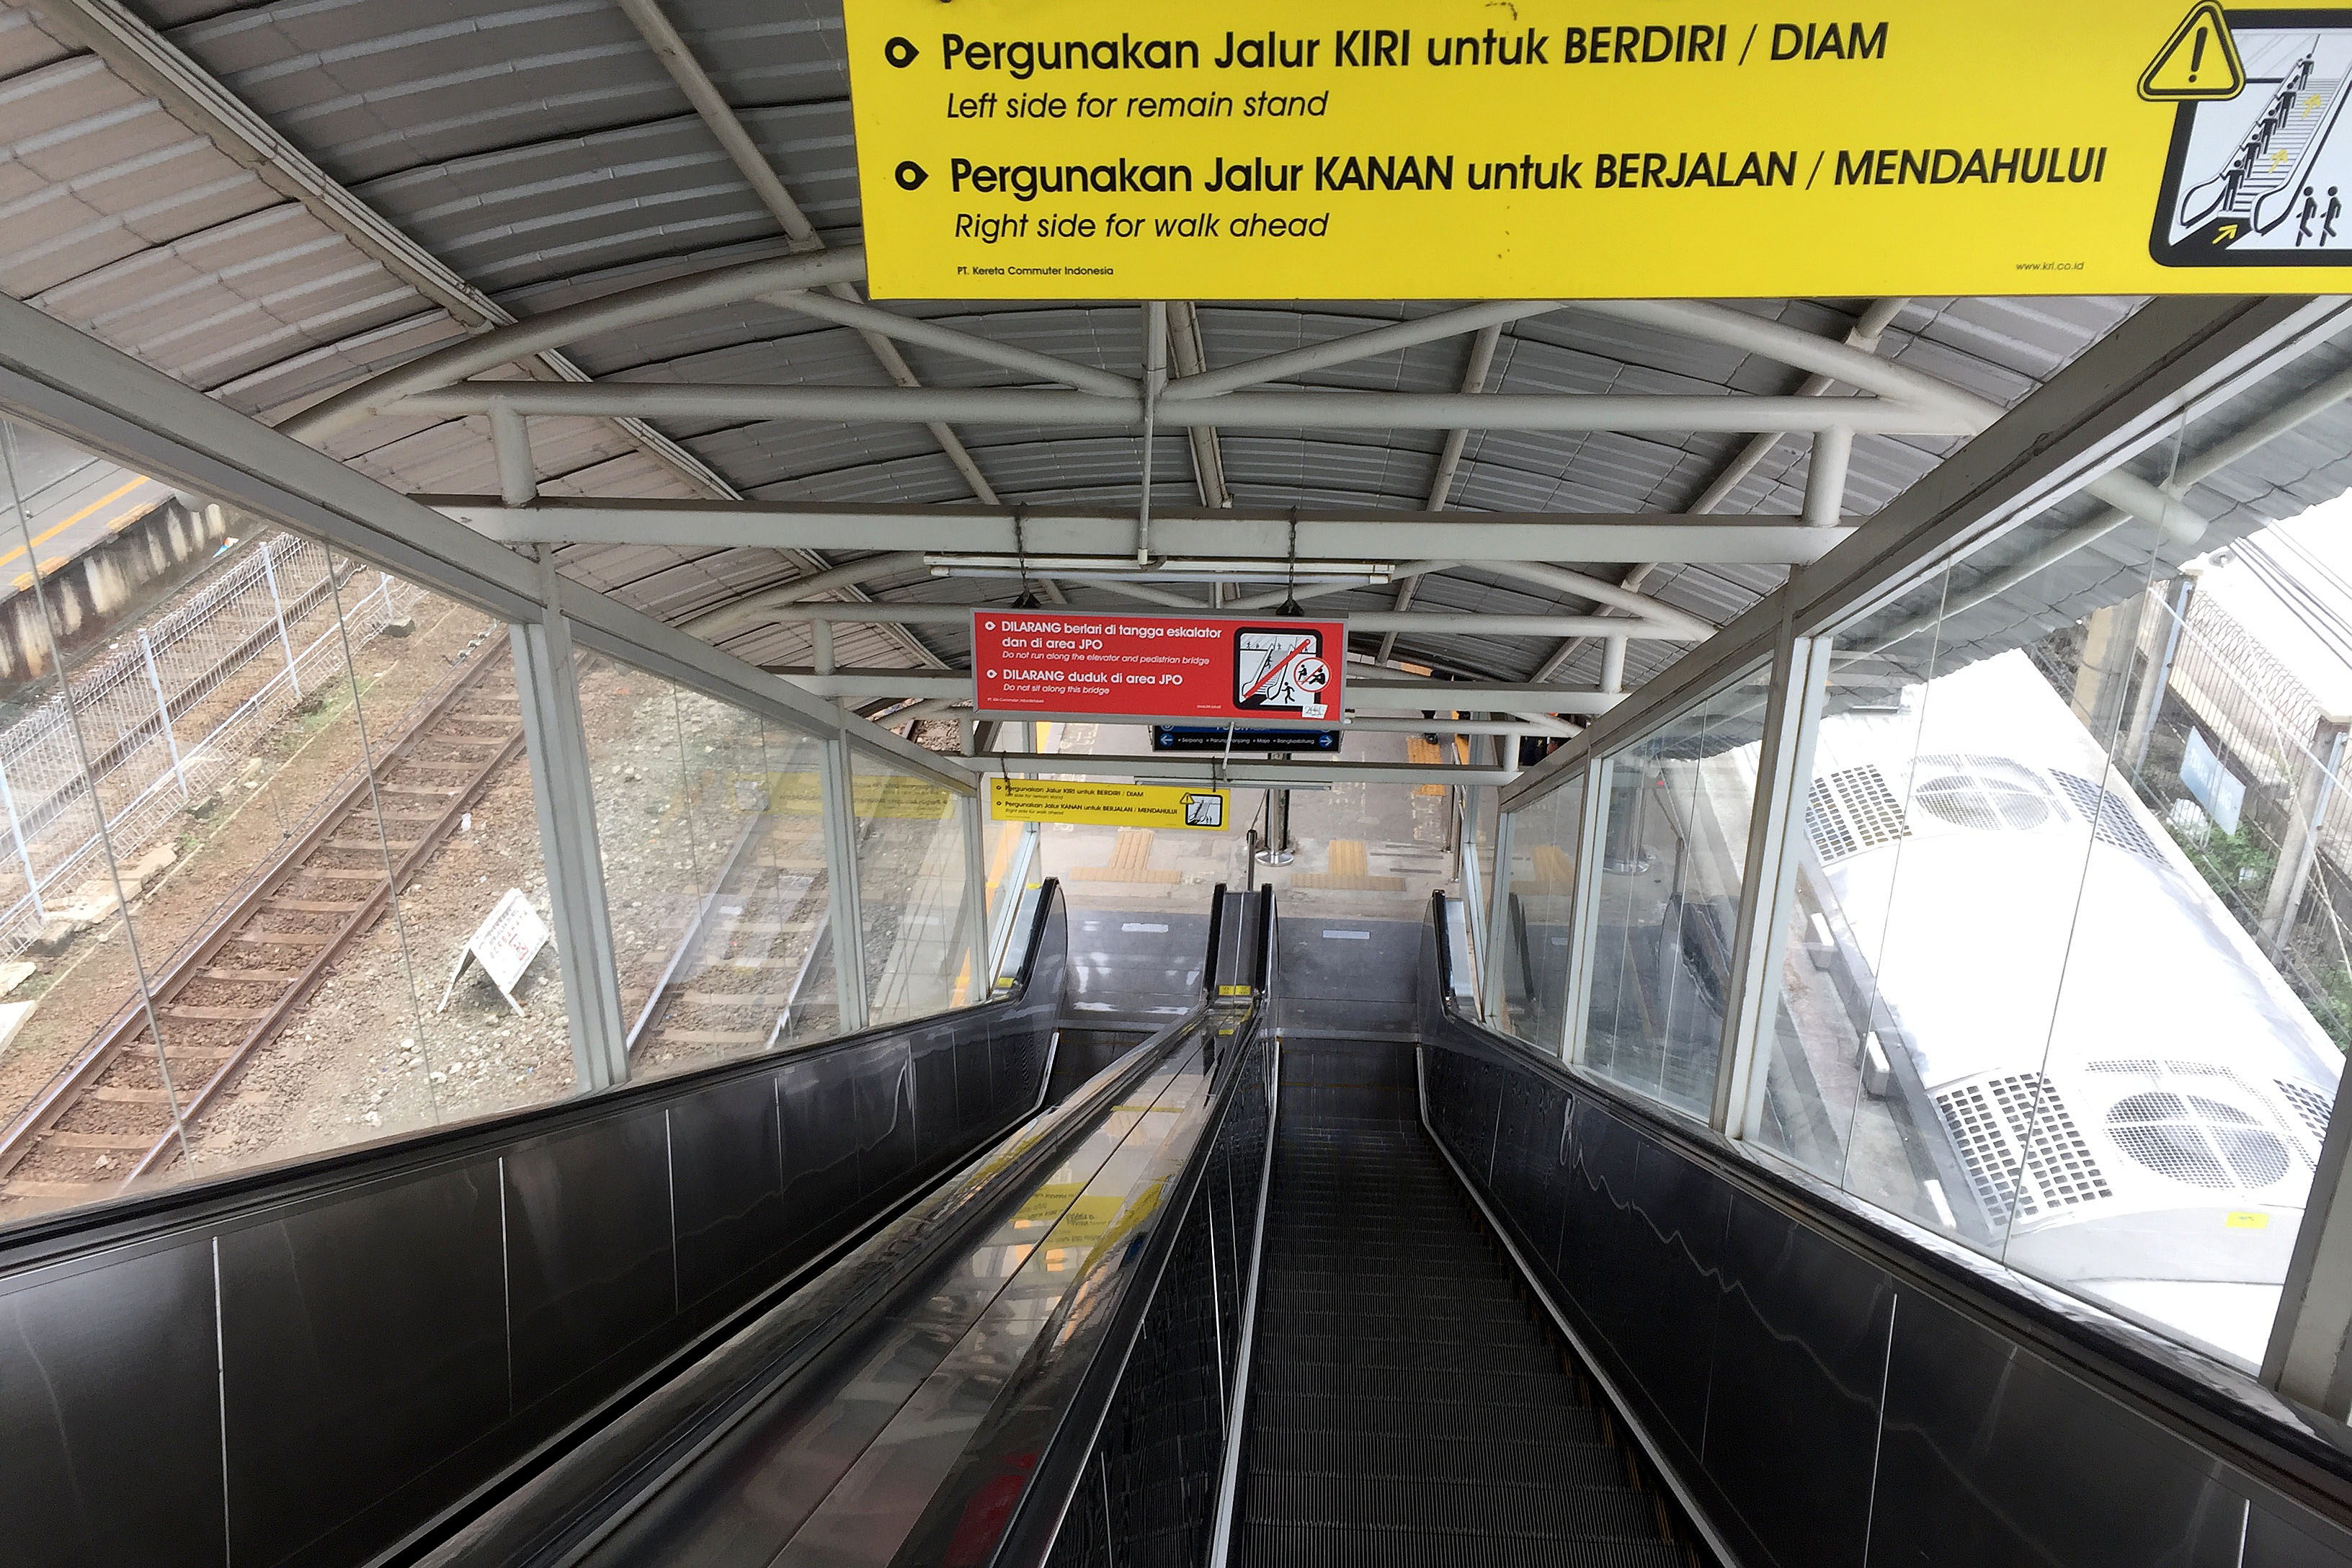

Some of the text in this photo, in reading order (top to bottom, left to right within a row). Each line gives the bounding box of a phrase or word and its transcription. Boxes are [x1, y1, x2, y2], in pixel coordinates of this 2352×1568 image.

[942, 22, 1889, 80] Pergunakan Jalur KIRI untuk BERDIRI / DIAM
[947, 90, 1329, 119] Left side for remain stand
[950, 146, 2108, 202] Pergunakan Jalur KANAN untuk BERJALAN / MENDAHULUI
[955, 212, 1330, 244] Right side for walk ahead
[957, 267, 1114, 275] PT. Kereta Commuter Indonesia
[2016, 262, 2085, 271] www.krl.co.id
[1002, 621, 1222, 638] DILARANG berlari di tangga eskalator
[1002, 637, 1103, 650] dan di area JPO
[1046, 652, 1069, 662] along
[1182, 656, 1209, 666] bridge
[1003, 669, 1183, 685] DILARANG duduk di area JPO
[1042, 685, 1065, 694] along
[1082, 687, 1110, 695] bridge
